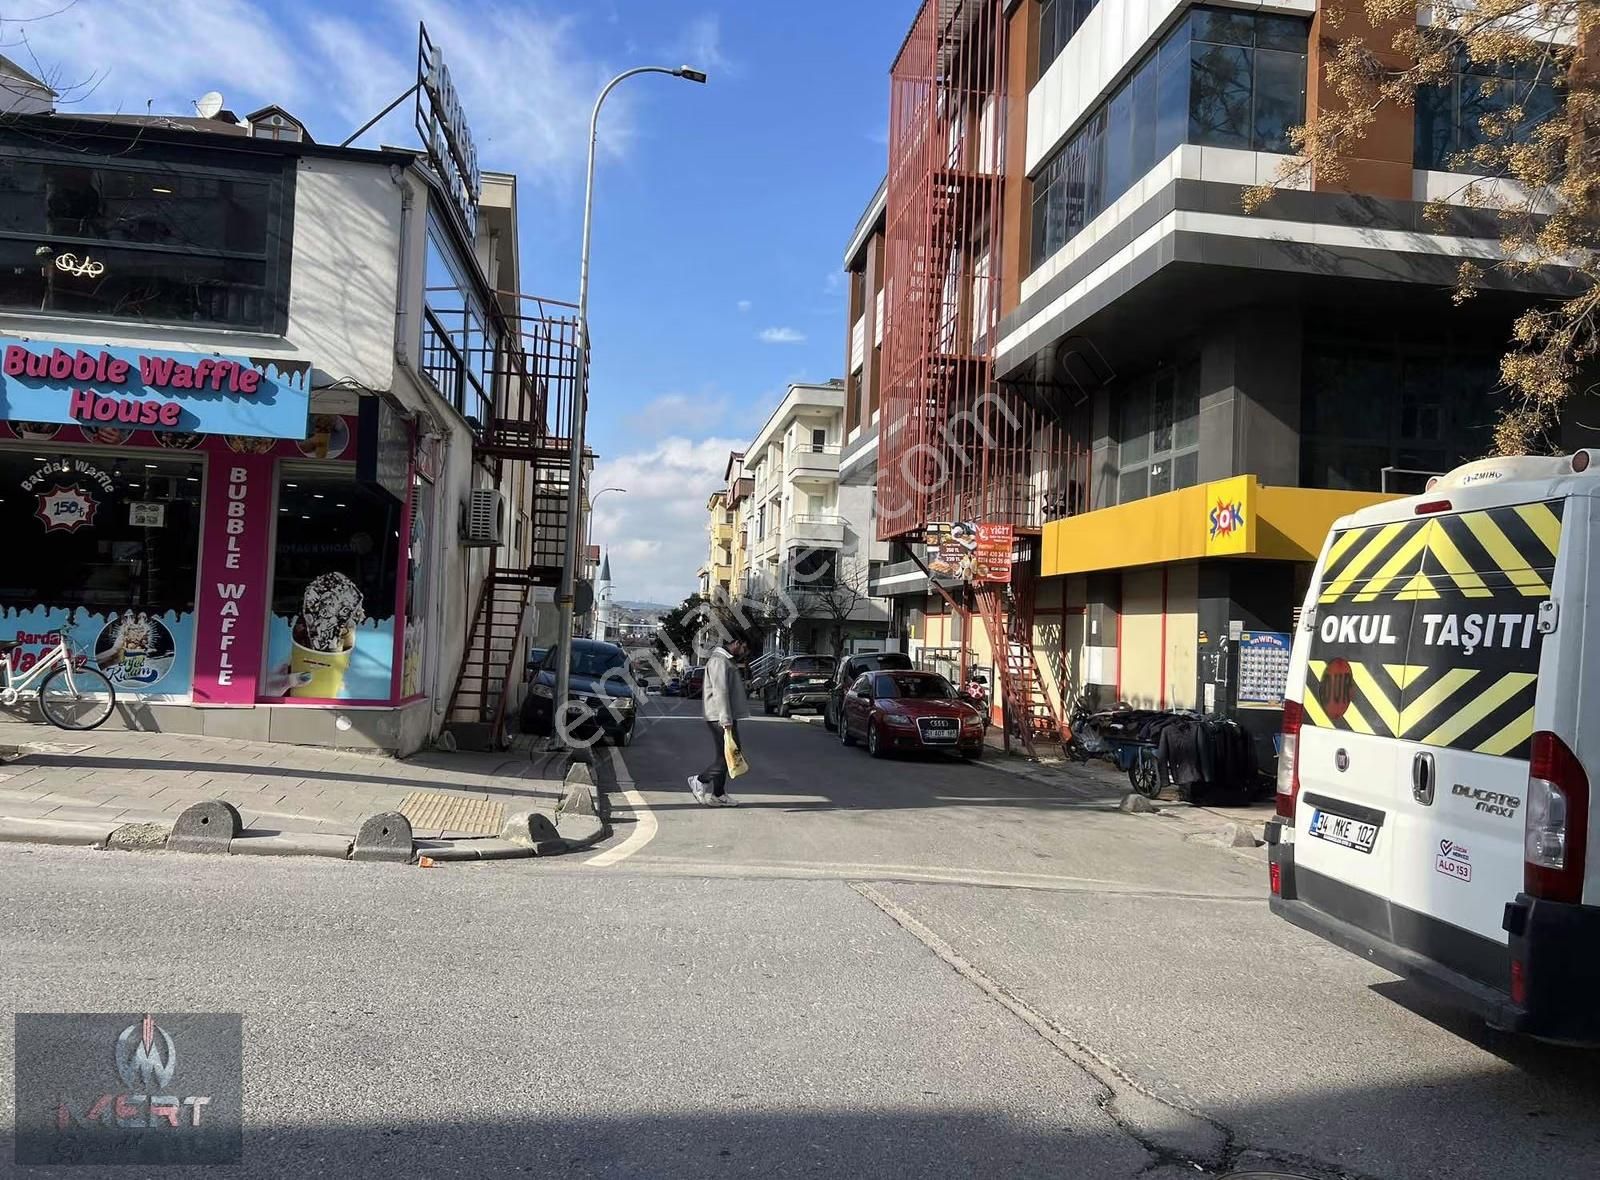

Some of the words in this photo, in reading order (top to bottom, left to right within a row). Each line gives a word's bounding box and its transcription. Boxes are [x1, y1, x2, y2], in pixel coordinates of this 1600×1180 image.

[3, 344, 128, 385] Bubble
[138, 356, 263, 394] Waffle
[69, 389, 181, 427] House
[21, 459, 69, 492] Bardak
[75, 459, 115, 493] Waffle
[225, 467, 247, 569] BUBBLE
[16, 630, 66, 645] Barda
[217, 583, 246, 686] WAFFLE
[1321, 614, 1397, 645] OKUL
[1423, 613, 1538, 656] TAŞITI
[1451, 783, 1521, 808] DUCATO
[1317, 814, 1328, 833] 34
[1333, 818, 1352, 839] MKE
[1357, 825, 1374, 845] 102
[1439, 860, 1454, 872] ALO
[1456, 865, 1468, 877] 153
